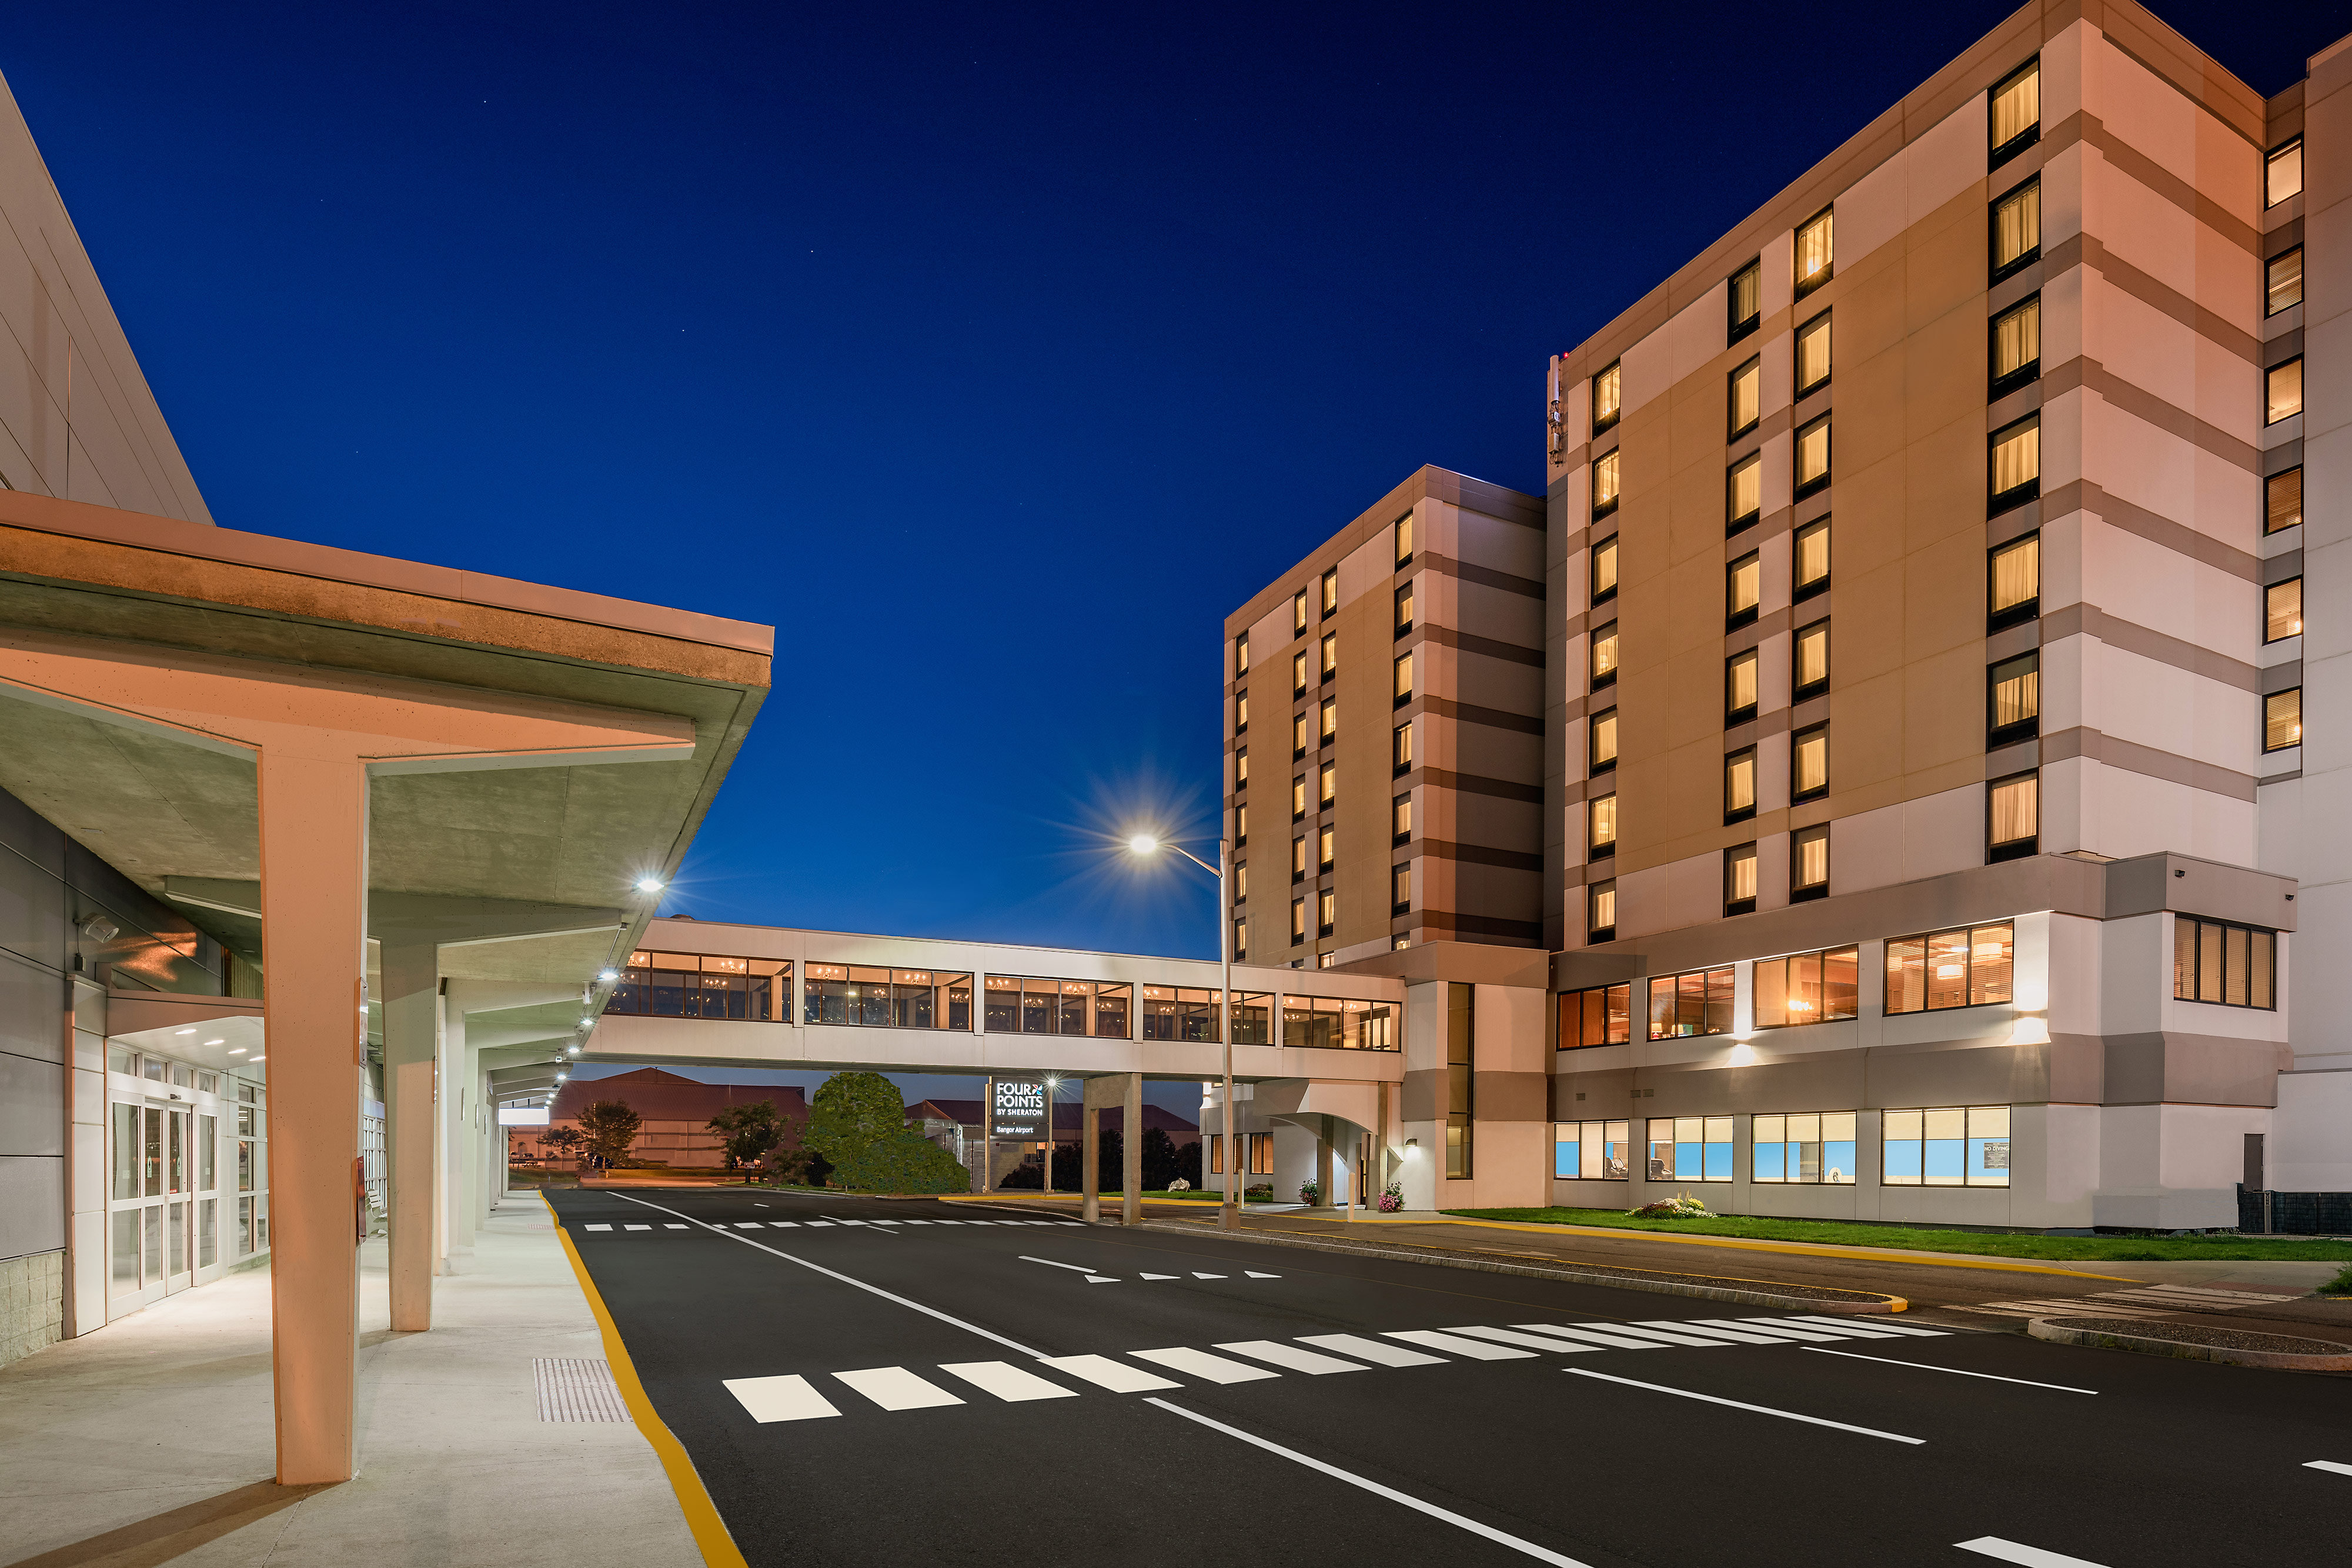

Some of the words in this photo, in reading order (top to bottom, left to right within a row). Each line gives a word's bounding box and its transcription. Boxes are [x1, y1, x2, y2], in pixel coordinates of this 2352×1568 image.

[997, 1083, 1032, 1095] FOUR
[997, 1095, 1043, 1108] POINTS
[997, 1126, 1015, 1134] Bangor
